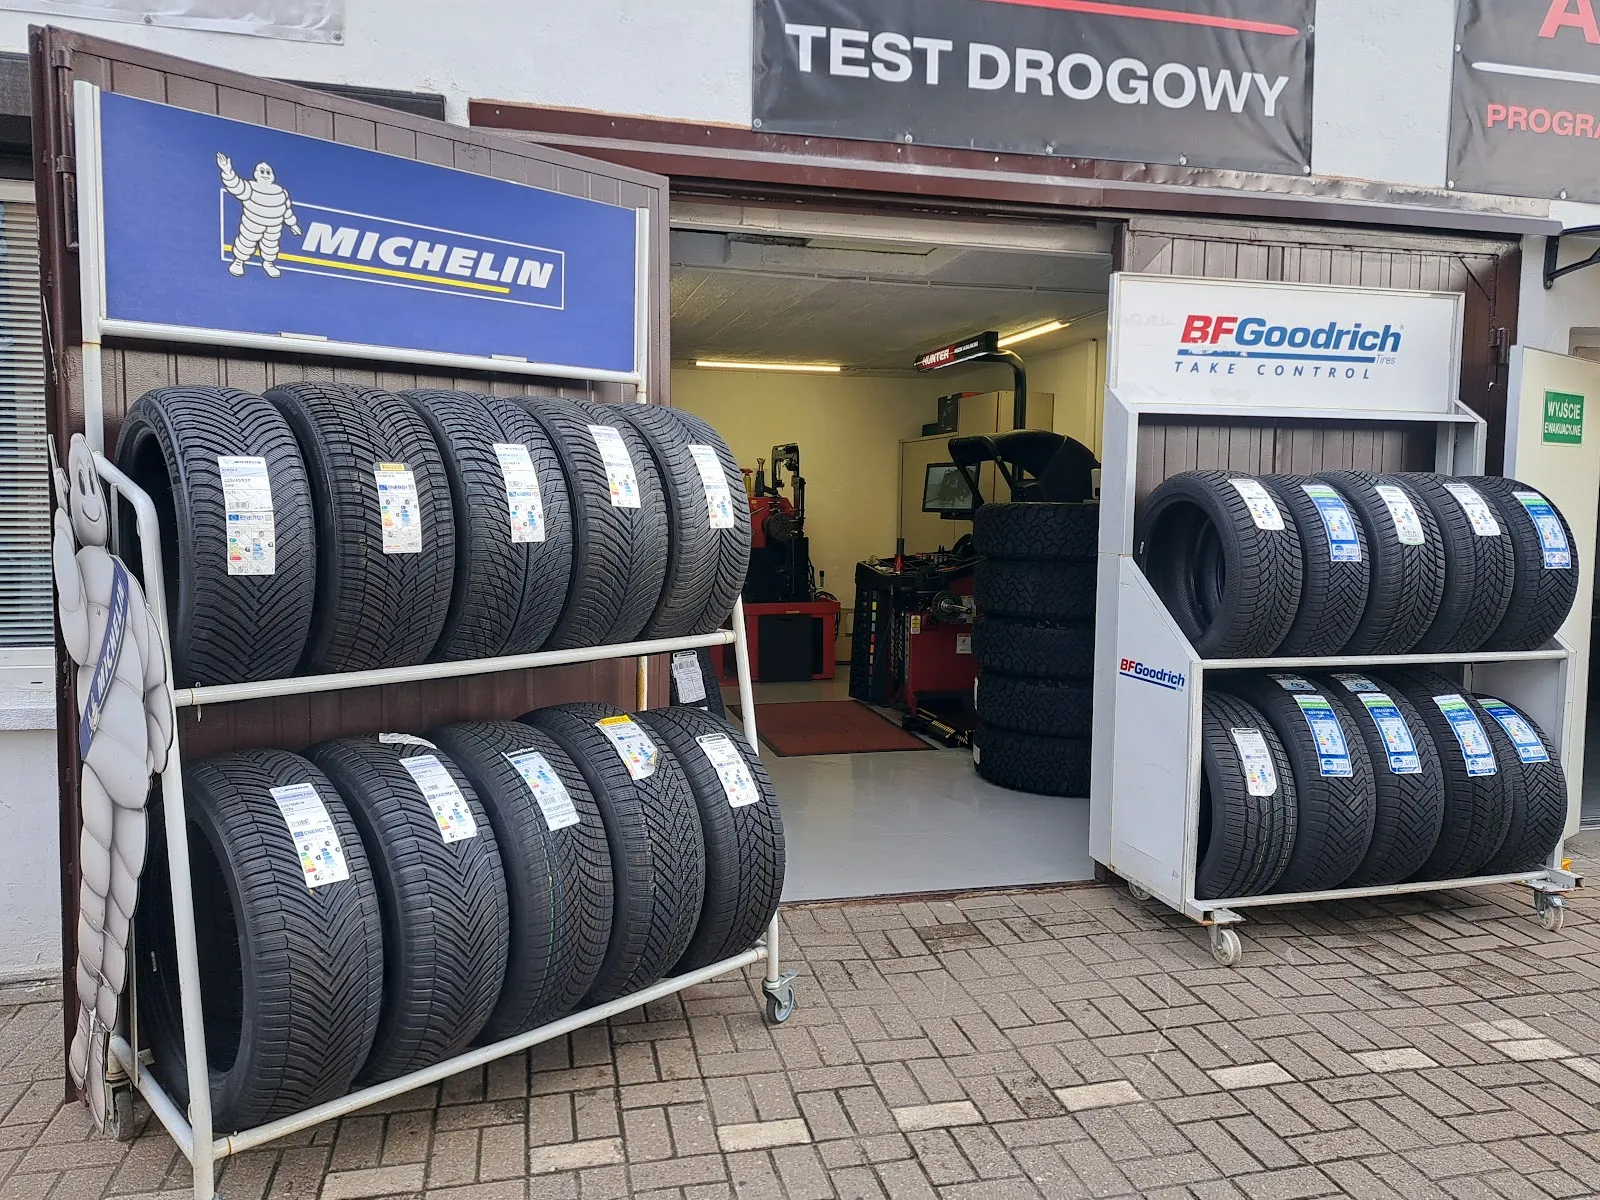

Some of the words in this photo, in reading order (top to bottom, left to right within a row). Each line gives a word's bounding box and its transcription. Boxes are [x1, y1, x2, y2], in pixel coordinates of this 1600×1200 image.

[784, 23, 953, 85] TEST
[967, 42, 1290, 118] DROGOWY
[302, 222, 554, 289] MICHELIN
[1181, 315, 1401, 352] BFGoodrich
[922, 348, 950, 366] HUNTER
[1376, 354, 1396, 365] Tires
[1175, 361, 1236, 375] TAKE
[1257, 364, 1370, 380] CONTROL
[1547, 399, 1581, 420] WYJŚCIE
[1544, 421, 1581, 436] EWAKUACYJNE
[97, 578, 126, 700] MICHELIN
[1120, 658, 1185, 687] BFGoodrich
